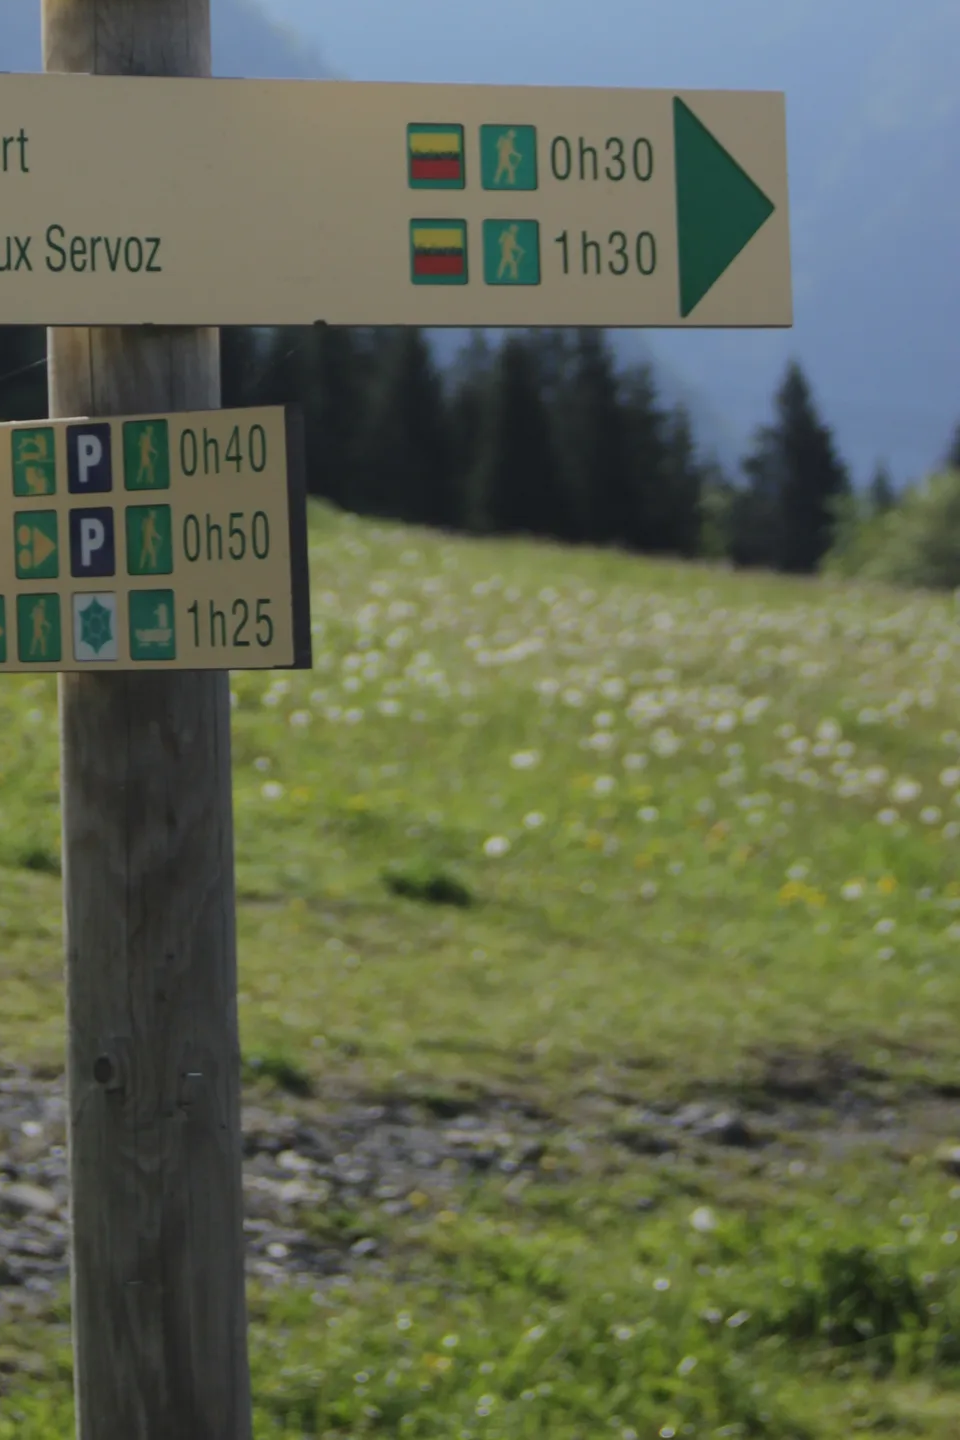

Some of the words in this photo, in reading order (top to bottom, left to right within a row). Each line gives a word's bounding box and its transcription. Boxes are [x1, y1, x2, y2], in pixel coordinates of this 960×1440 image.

[551, 136, 653, 181] 0h30
[46, 225, 161, 272] Servoz
[556, 231, 656, 275] 1h30
[78, 435, 102, 482] P
[181, 424, 266, 476] 0h40
[81, 519, 104, 566] P
[184, 511, 269, 562] 0h50
[188, 599, 273, 647] 1h25
